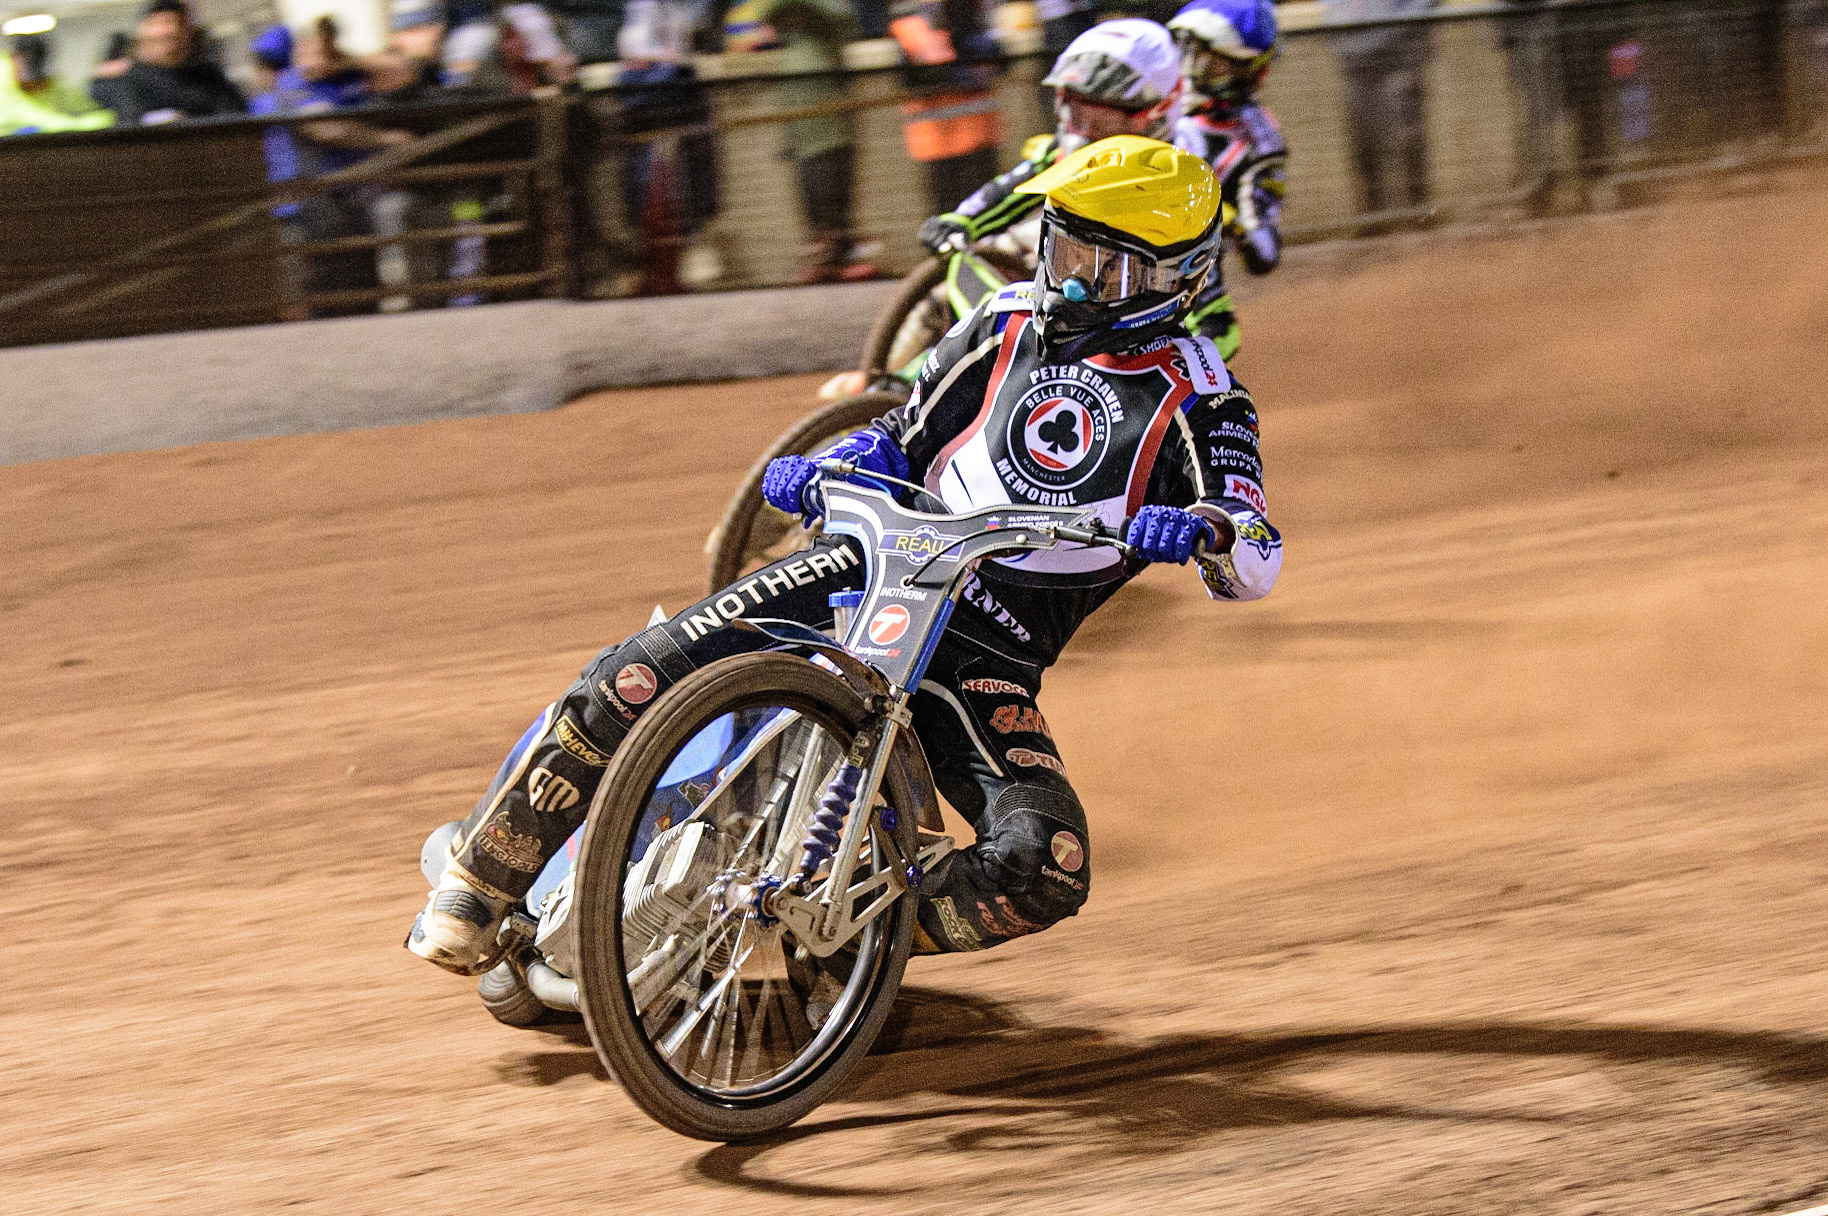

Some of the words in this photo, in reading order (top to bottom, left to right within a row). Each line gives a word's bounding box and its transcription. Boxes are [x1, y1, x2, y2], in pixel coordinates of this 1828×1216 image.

[1025, 386, 1063, 410] BELLE
[1069, 386, 1094, 408] VUE
[1091, 408, 1105, 441] ACES
[1029, 365, 1080, 385] PETER
[1080, 369, 1124, 424] CRAVEN
[996, 457, 1077, 506] MEMORIAL
[1023, 458, 1066, 482] MANCHESTER
[1210, 459, 1252, 472] GRUPA
[679, 544, 860, 642] INOTHERM
[880, 587, 928, 601] INOTHERM
